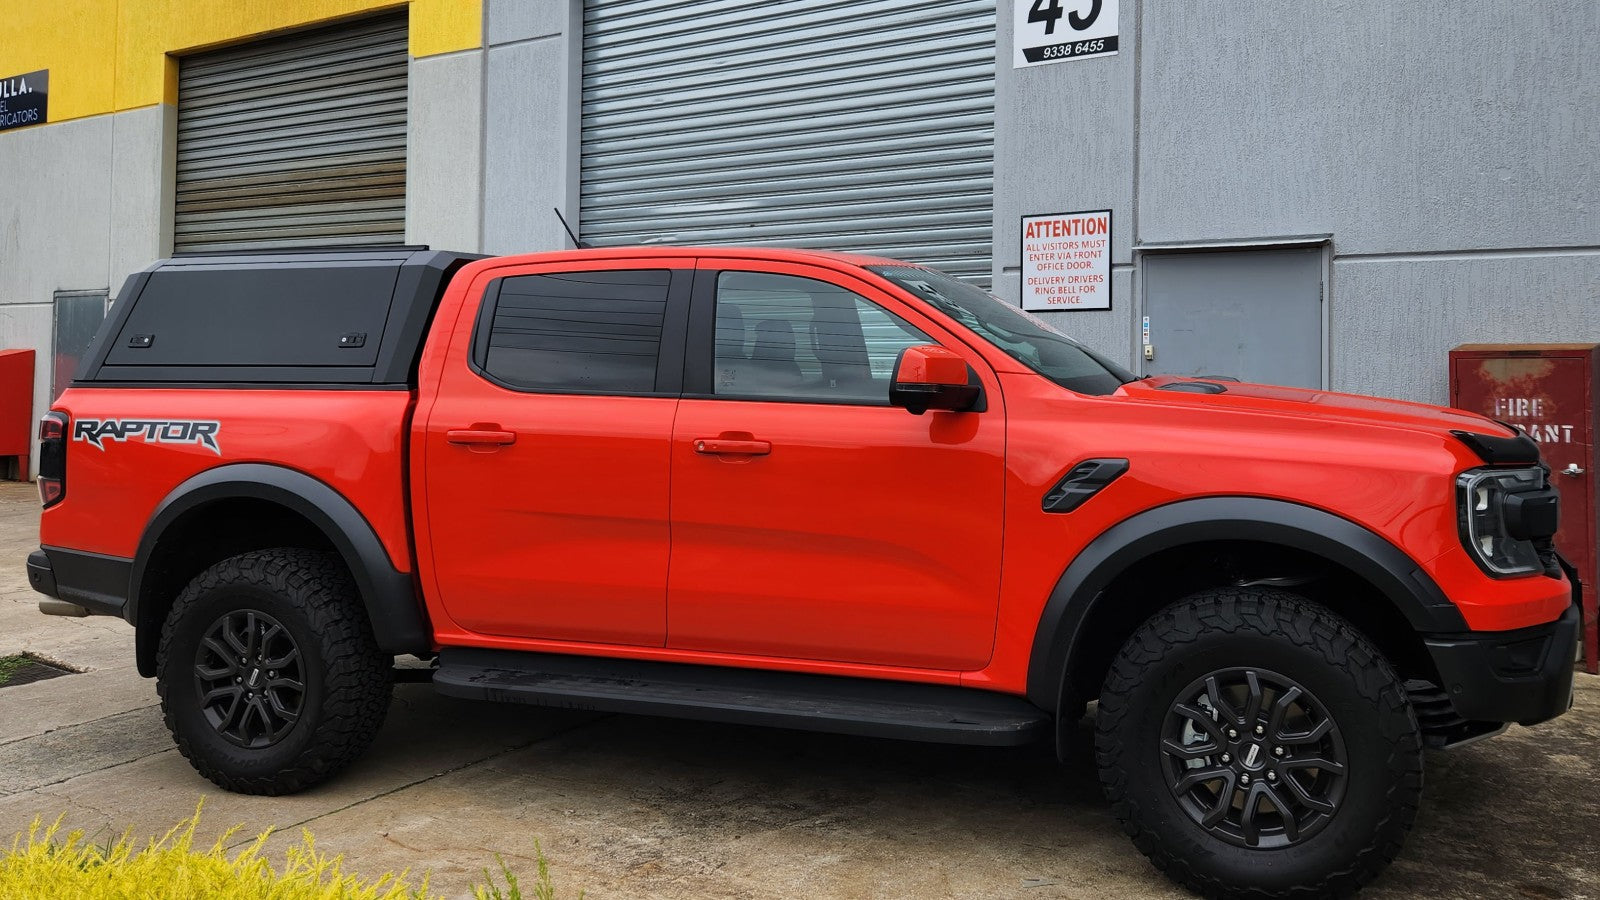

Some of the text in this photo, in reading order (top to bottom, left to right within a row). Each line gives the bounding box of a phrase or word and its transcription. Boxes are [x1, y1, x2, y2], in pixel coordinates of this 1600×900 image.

[1043, 39, 1105, 58] 9338 6455
[1026, 217, 1107, 239] ATTENTION
[1026, 239, 1106, 252] ALL VISITORS MUST
[1029, 250, 1103, 261] ENTER VIA FRONT
[1037, 261, 1094, 271] OFFICE DOOR.
[1027, 274, 1104, 286] DELIVERY DRIVERS
[1035, 285, 1096, 295] RING BELL FOR
[1047, 296, 1083, 305] SERVICE.
[1495, 398, 1544, 417] FIRE
[73, 418, 222, 456] RAPTOR
